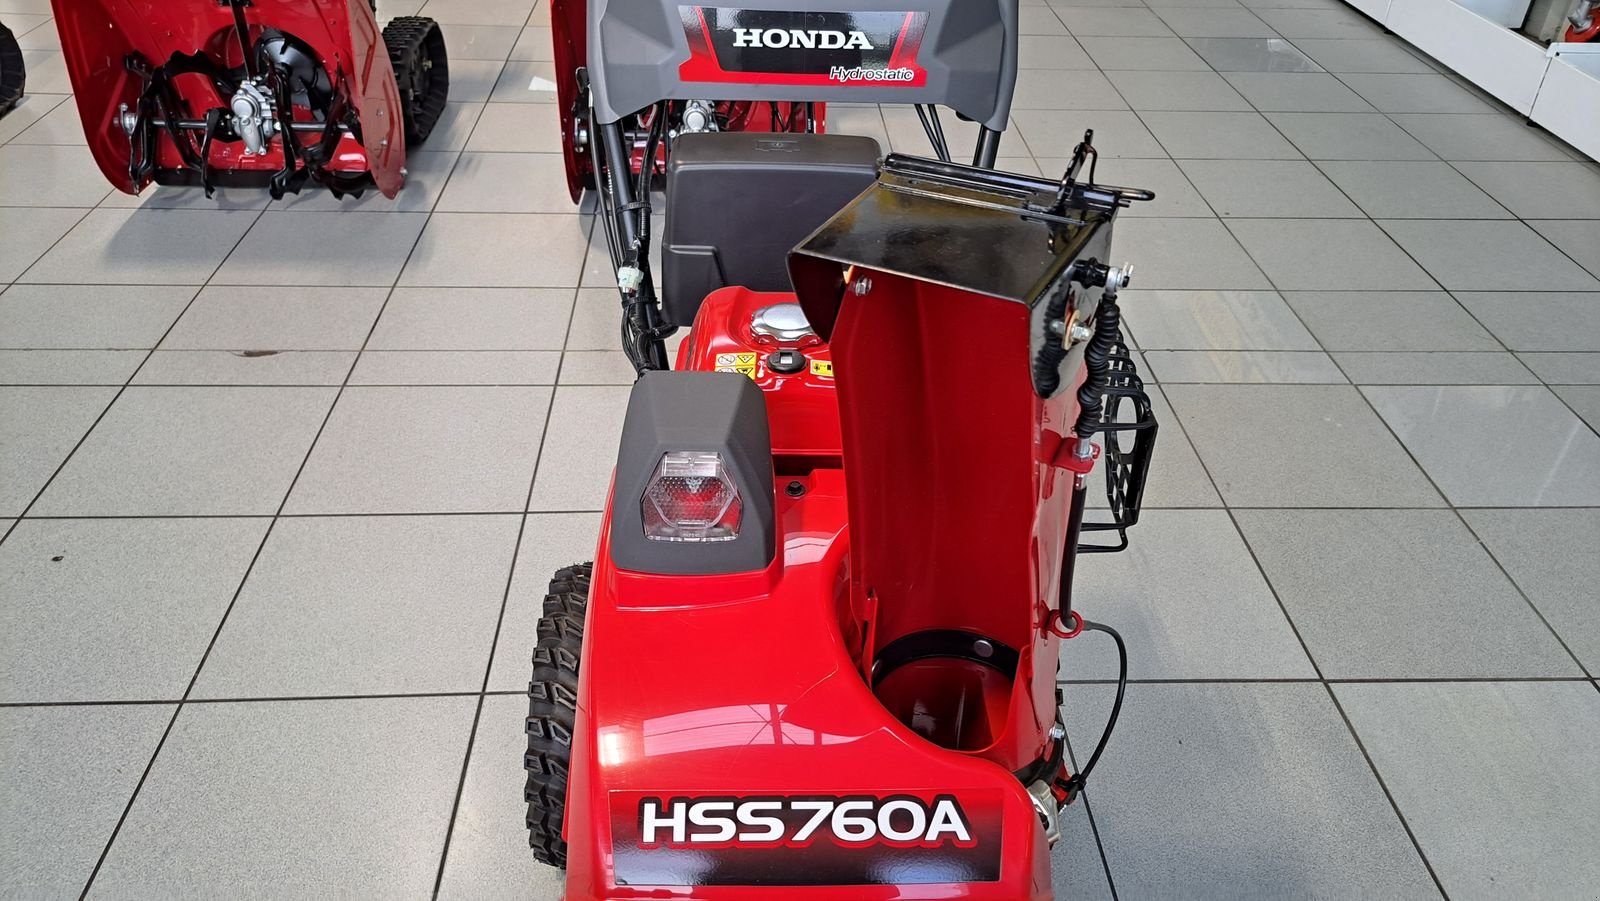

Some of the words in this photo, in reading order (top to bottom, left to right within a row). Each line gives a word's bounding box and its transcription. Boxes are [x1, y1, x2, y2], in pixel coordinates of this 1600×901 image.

[733, 28, 874, 50] HONDA
[829, 66, 914, 82] Hydrostatic
[642, 800, 970, 842] HSS760A
